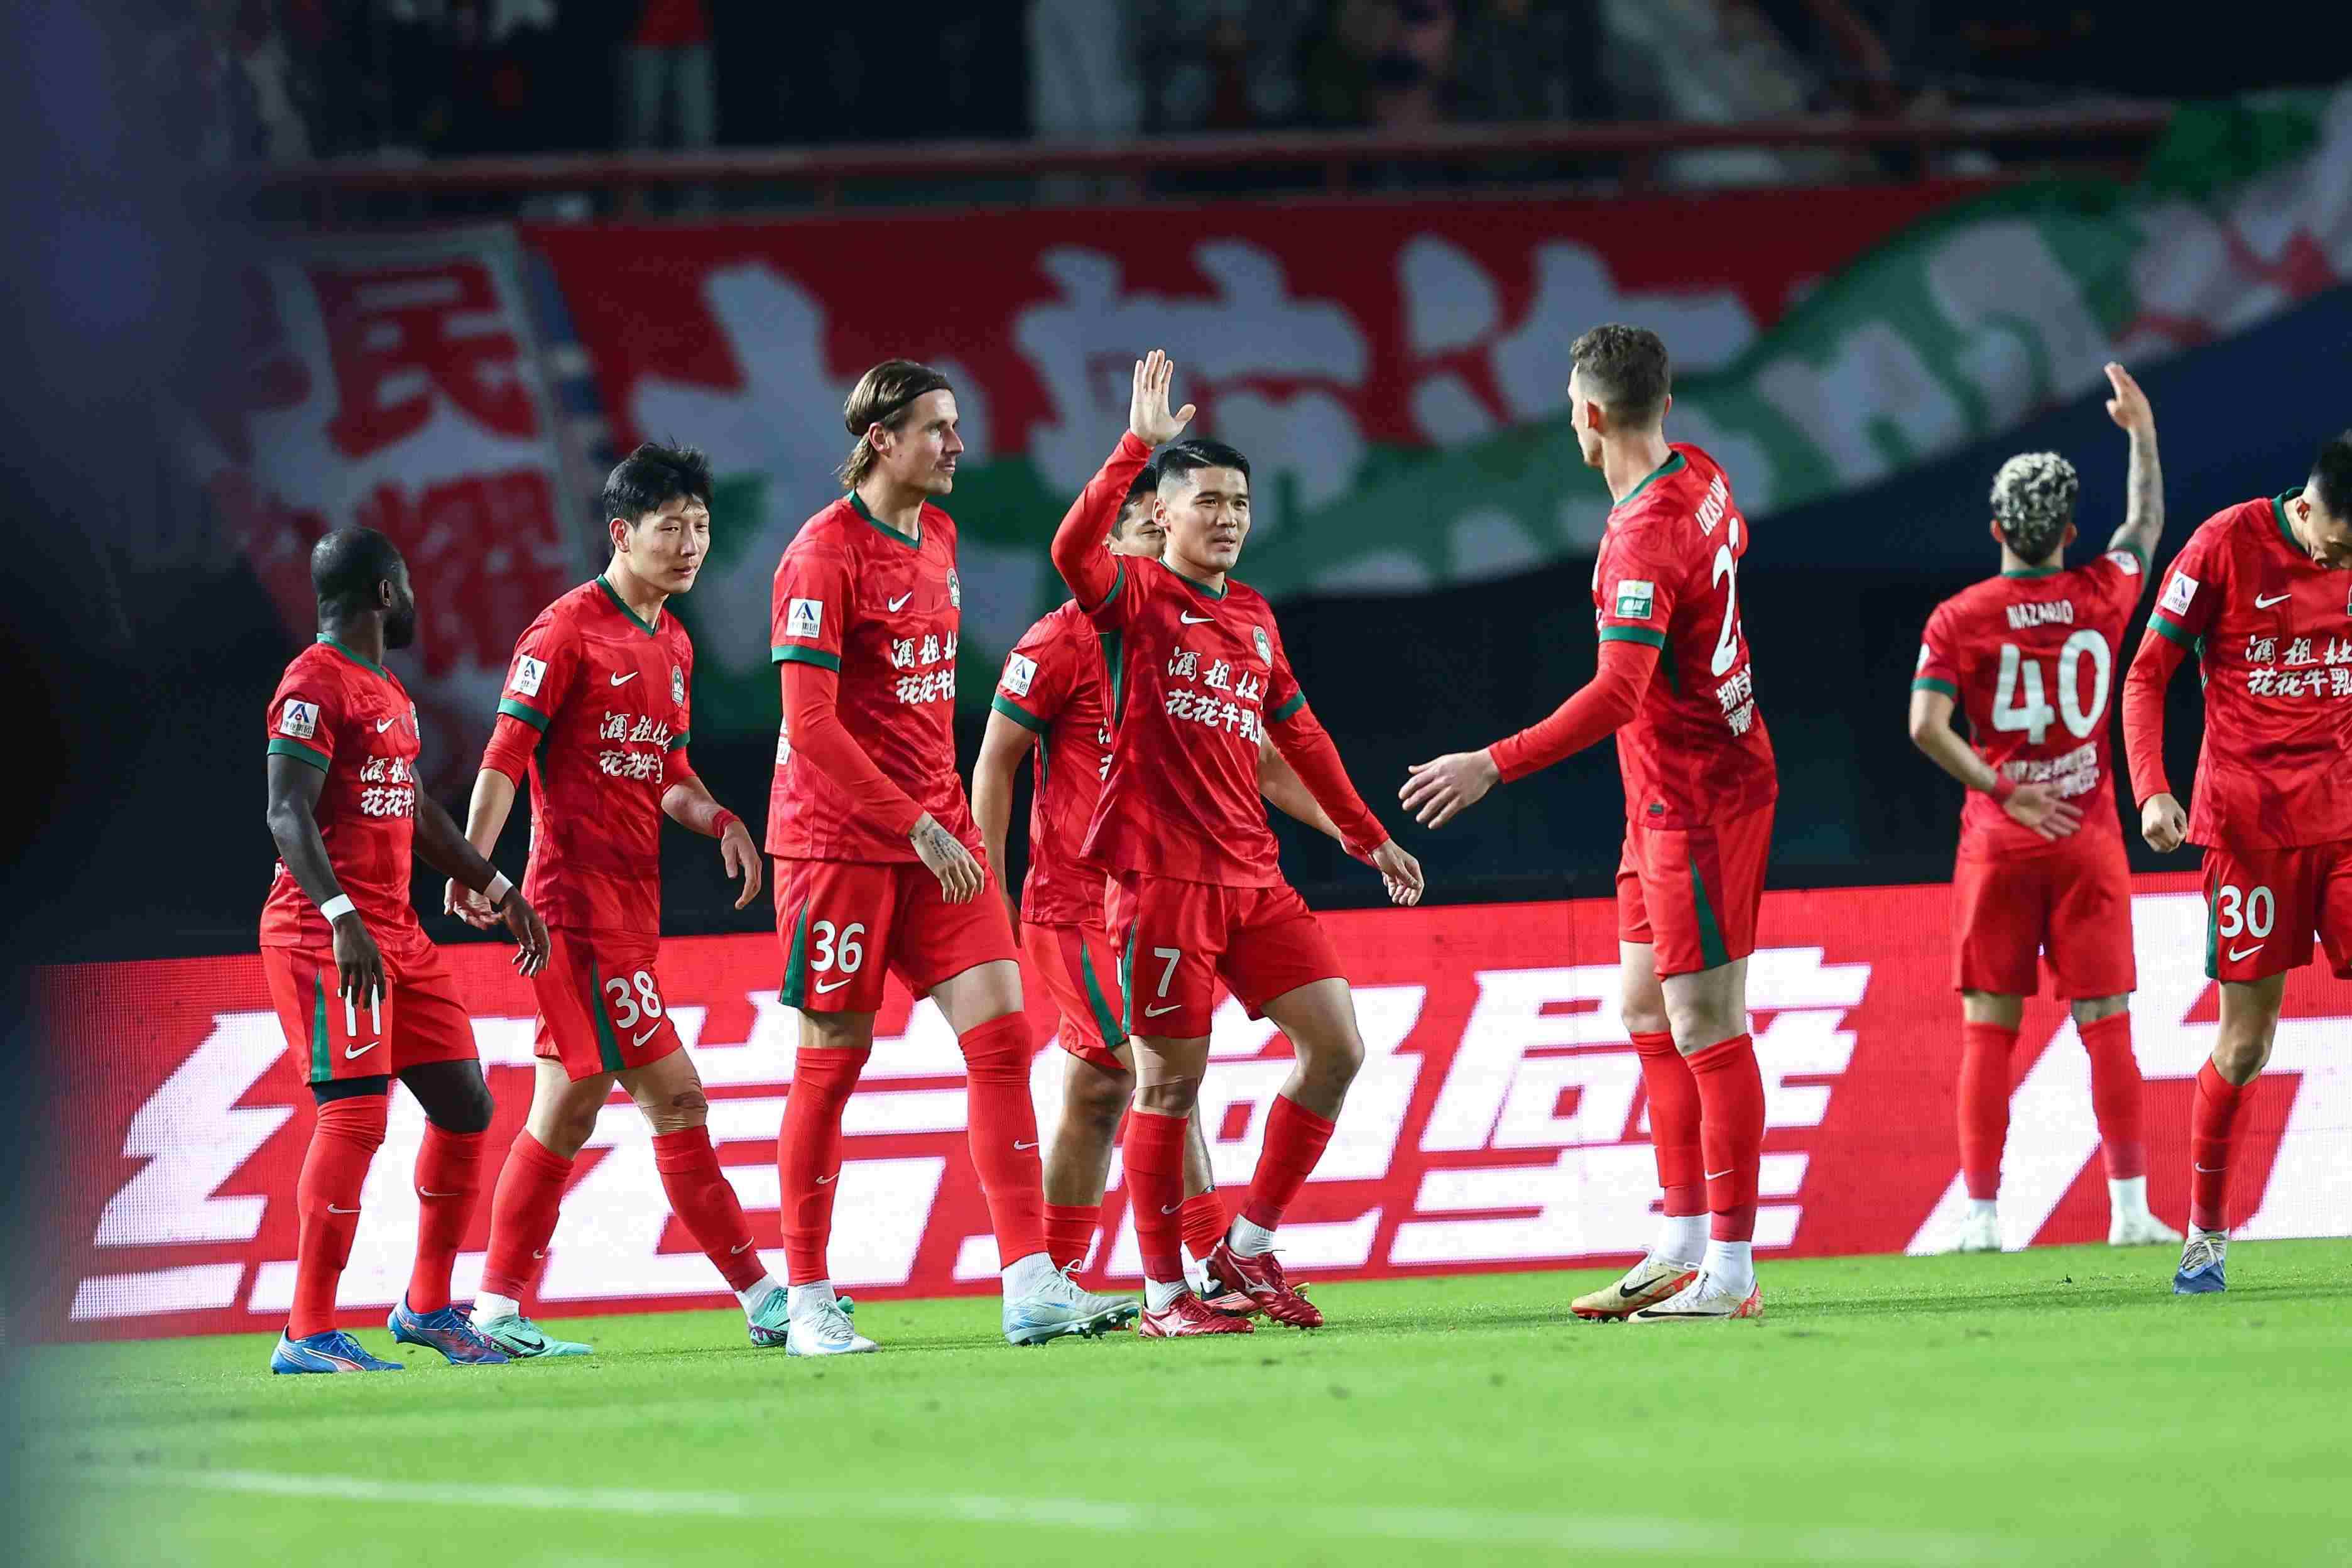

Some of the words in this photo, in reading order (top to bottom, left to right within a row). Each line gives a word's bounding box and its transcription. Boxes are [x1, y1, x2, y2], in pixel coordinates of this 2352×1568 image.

[2006, 599, 2074, 629] NAZARIO
[1167, 646, 1268, 710] 酒祖杜
[1991, 629, 2111, 745] 40
[1165, 689, 1262, 747] 花花牛乳
[2219, 885, 2275, 939] 30
[810, 920, 864, 974] 36
[1153, 947, 1181, 998] 7
[605, 969, 665, 1029] 38
